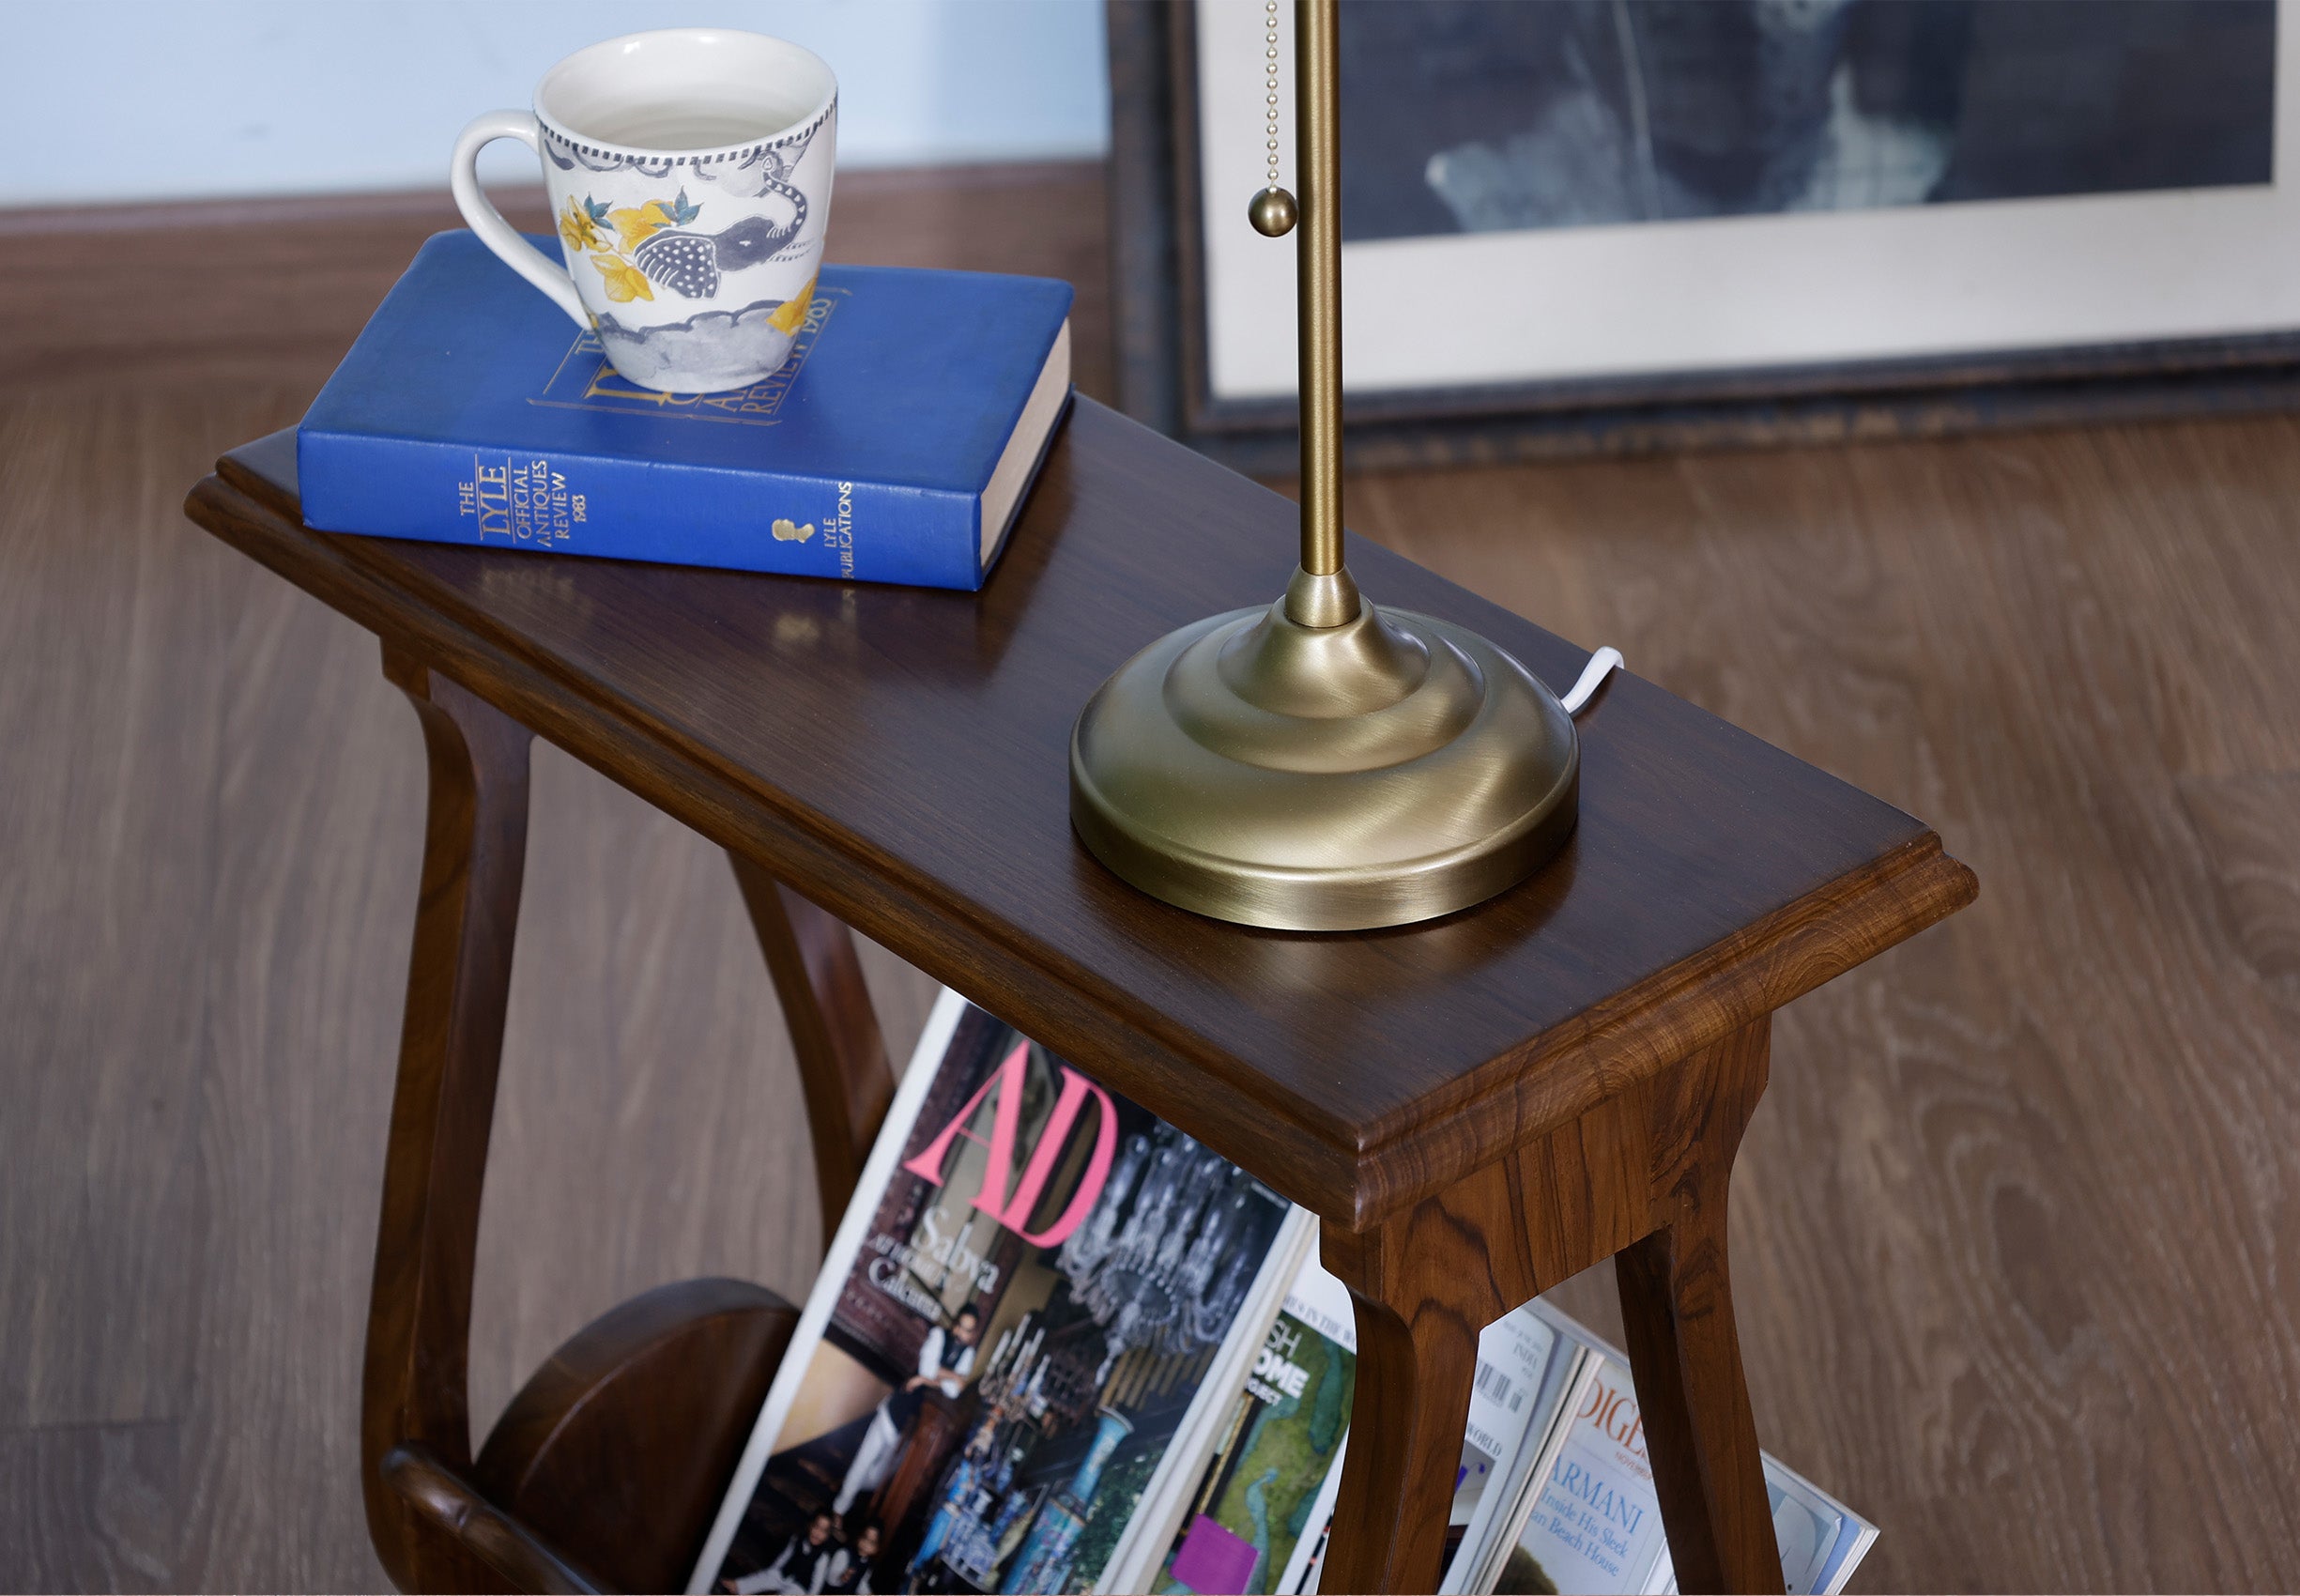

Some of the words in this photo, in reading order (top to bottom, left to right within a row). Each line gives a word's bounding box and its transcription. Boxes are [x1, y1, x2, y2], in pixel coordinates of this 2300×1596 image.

[458, 482, 475, 516] THE
[479, 466, 511, 536] LYLE
[514, 466, 532, 540] OFFICIAL
[531, 459, 552, 547] ANTIQUES
[551, 471, 571, 540] REVIEW
[572, 494, 588, 523] 1983
[823, 517, 837, 547] LYLE
[837, 480, 855, 579] PUBLICATIONS
[903, 1039, 1118, 1250] AD
[1253, 1346, 1311, 1399] OME
[1266, 1319, 1302, 1358] SH
[1576, 1377, 1648, 1458] DIGE
[1530, 1511, 1548, 1527] an
[1548, 1516, 1583, 1552] Beach
[1584, 1541, 1619, 1577] House
[1540, 1487, 1576, 1521] Inside
[1577, 1512, 1598, 1538] His
[1599, 1527, 1629, 1558] Sleek
